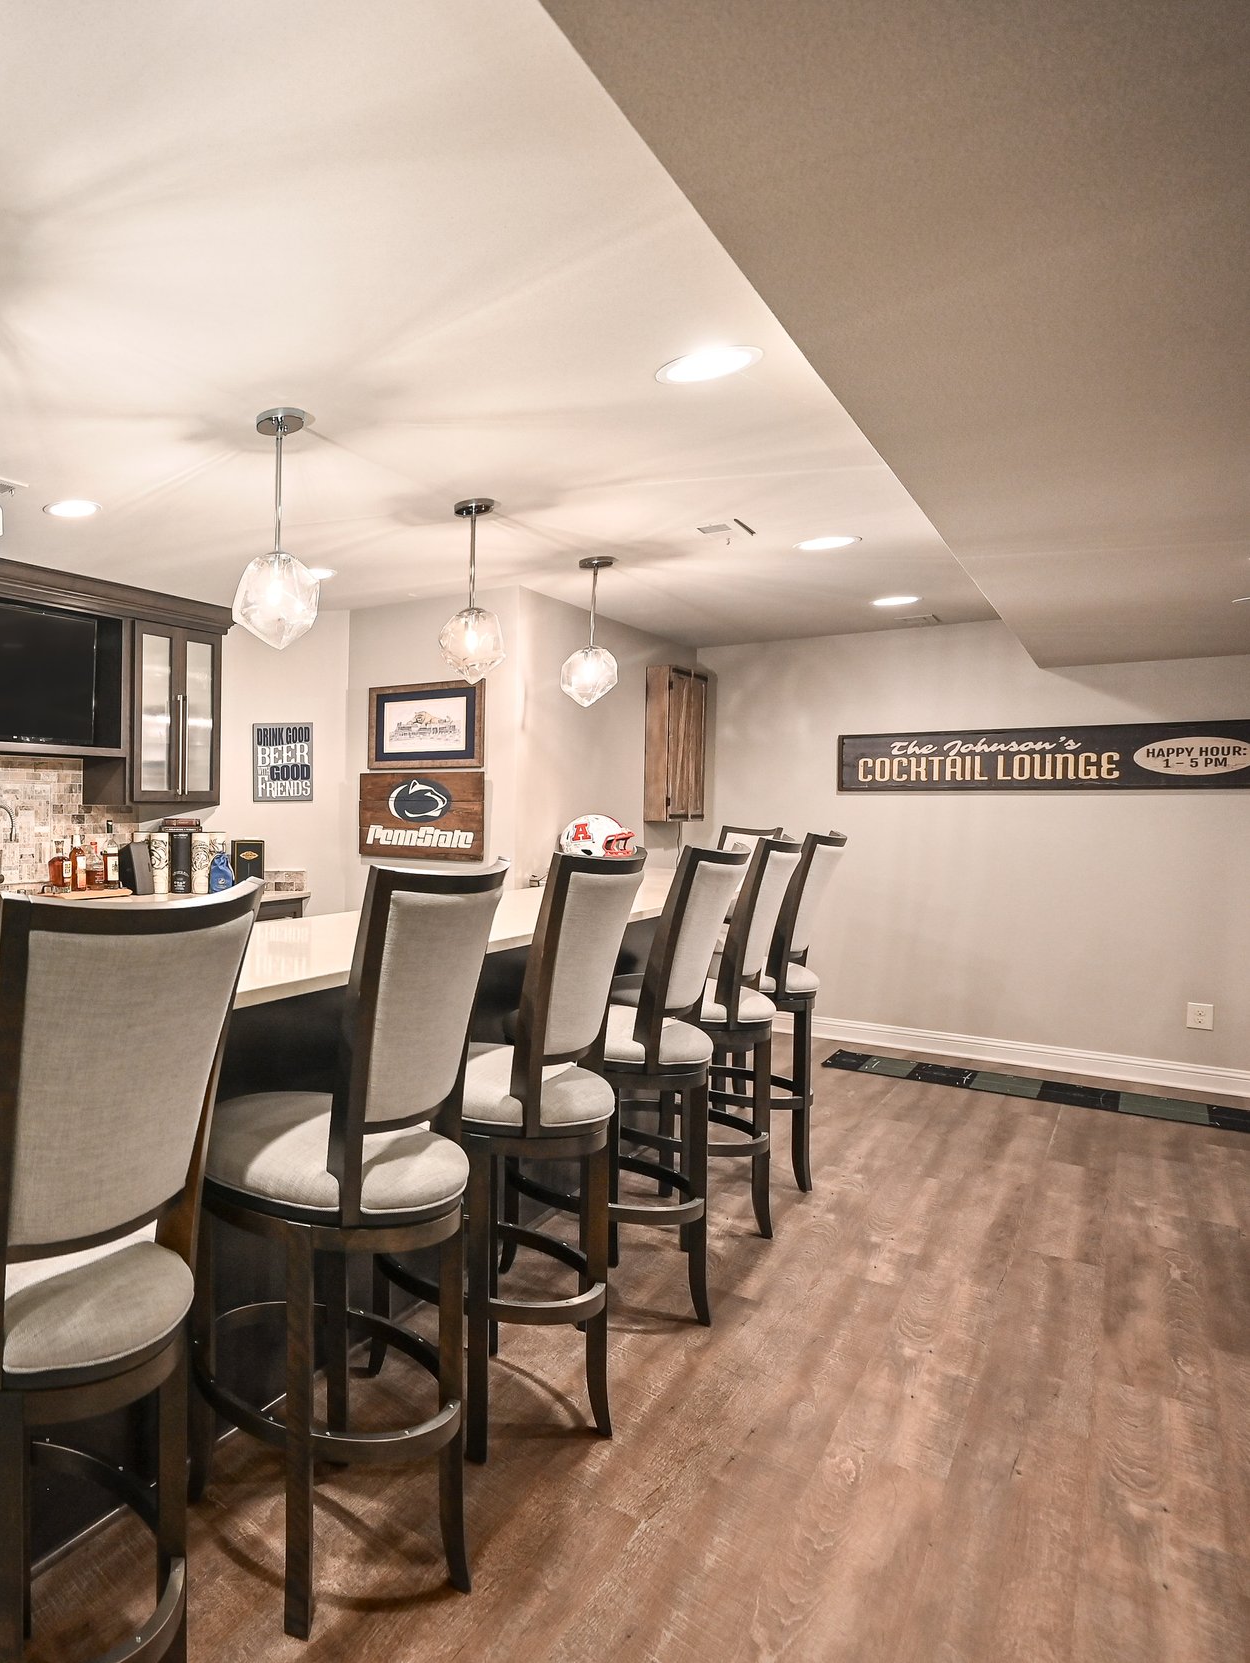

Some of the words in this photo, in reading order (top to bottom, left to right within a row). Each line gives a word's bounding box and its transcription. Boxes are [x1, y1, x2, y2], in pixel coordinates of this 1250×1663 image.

[257, 728, 284, 746] DRINK
[286, 727, 310, 744] GOOD
[257, 743, 310, 767] BEER
[891, 739, 938, 755] The
[944, 736, 1082, 756] Johnson's
[1146, 747, 1194, 758] HAPPY
[1199, 746, 1248, 757] HOUR:
[858, 754, 988, 782] COCKTAIL
[997, 751, 1120, 781] LOUNGE
[1163, 758, 1171, 768] 1
[1190, 757, 1199, 768] 5
[1204, 757, 1228, 768] PM
[270, 764, 310, 781] GOOD
[572, 823, 592, 841] A
